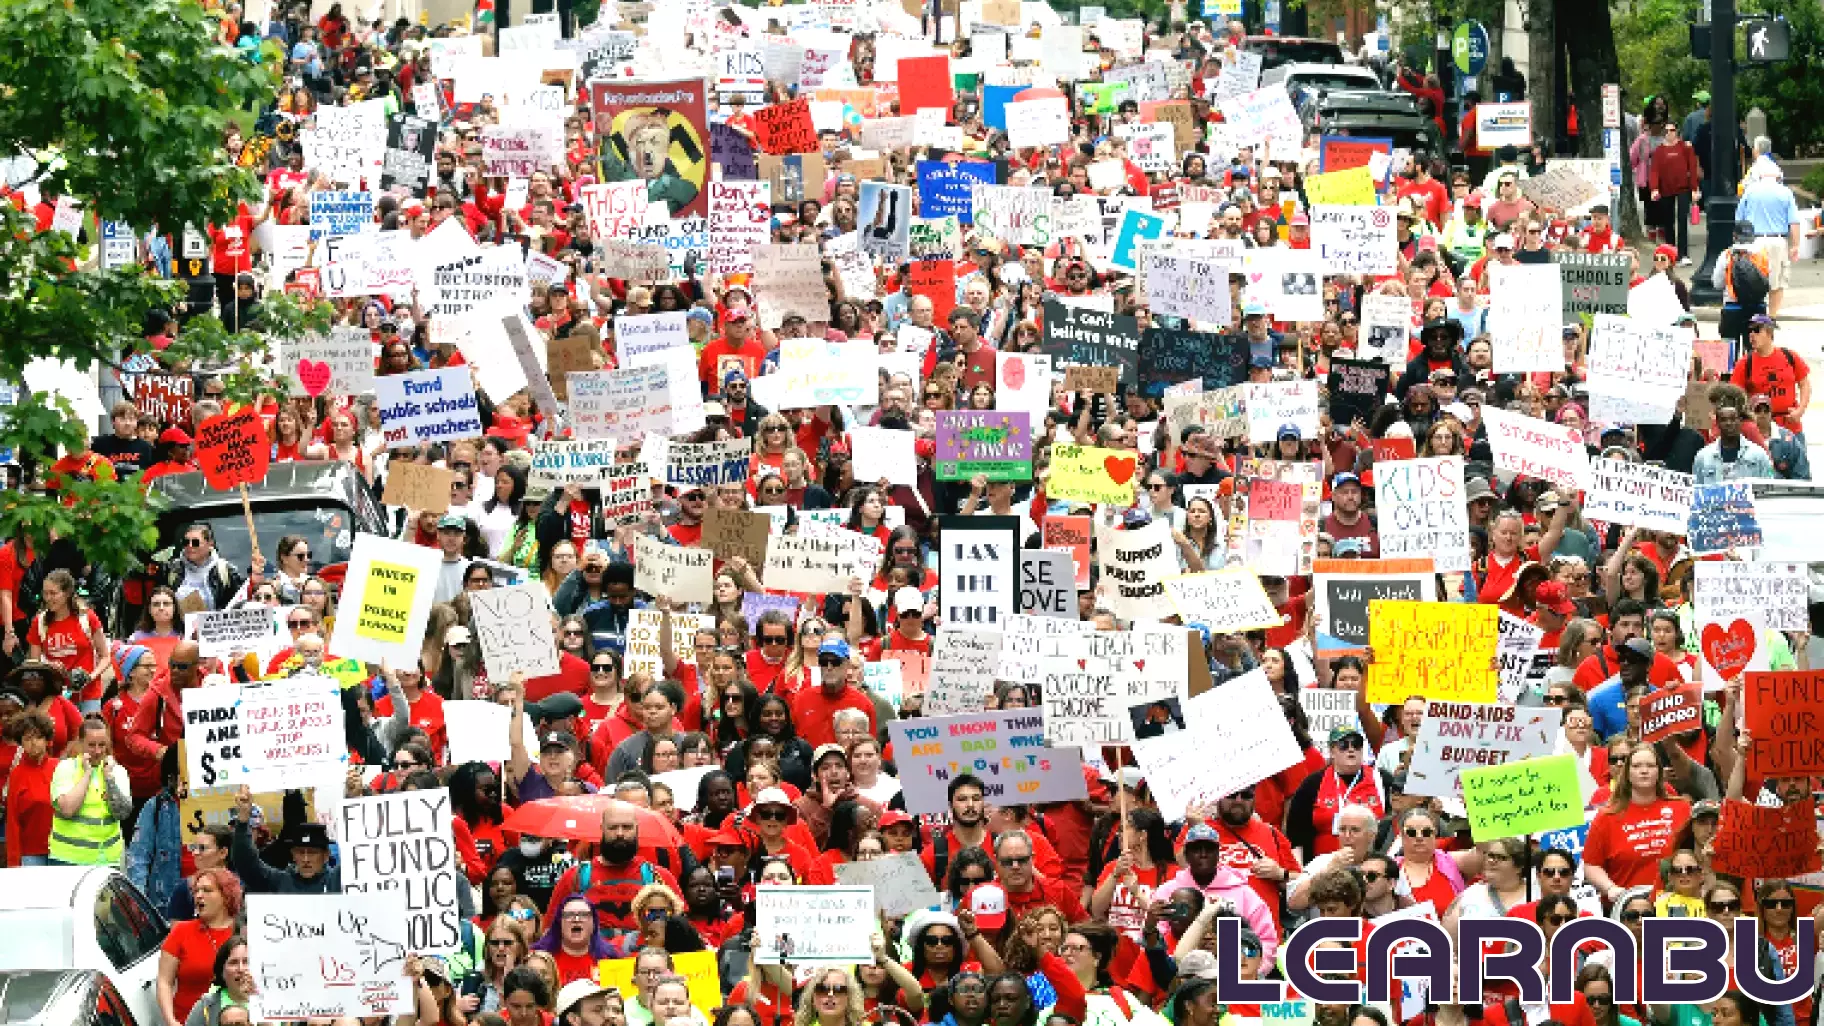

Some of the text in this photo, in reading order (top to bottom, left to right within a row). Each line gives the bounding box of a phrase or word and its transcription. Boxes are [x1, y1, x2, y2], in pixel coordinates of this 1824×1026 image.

[727, 53, 764, 76] KIDS
[629, 222, 671, 241] FUND
[433, 272, 524, 289] INCLUSION
[1064, 305, 1077, 324] I
[403, 376, 443, 396] Fund
[380, 394, 476, 424] public schools
[383, 418, 481, 443] not vouchers
[1379, 458, 1457, 502] KIDS
[1393, 500, 1458, 531] OVER
[953, 542, 1000, 562] TAX
[956, 574, 1000, 593] THE
[472, 590, 534, 620] NO
[637, 611, 703, 632] FUNING
[1045, 672, 1117, 697] OUTCOME
[1427, 702, 1516, 722] BAND-AIDS
[904, 727, 940, 744] YOU
[948, 721, 997, 741] KNOW
[1437, 722, 1525, 742] DON'T FIX
[1769, 711, 1820, 738] OUR
[911, 743, 943, 757] ARE
[961, 737, 997, 755] BAD
[1440, 746, 1511, 767] BUDGET
[1017, 781, 1041, 796] UP
[344, 795, 448, 843] FULLY
[352, 836, 451, 881] FUND
[263, 909, 369, 943] Show Up
[261, 955, 356, 990] For Us
